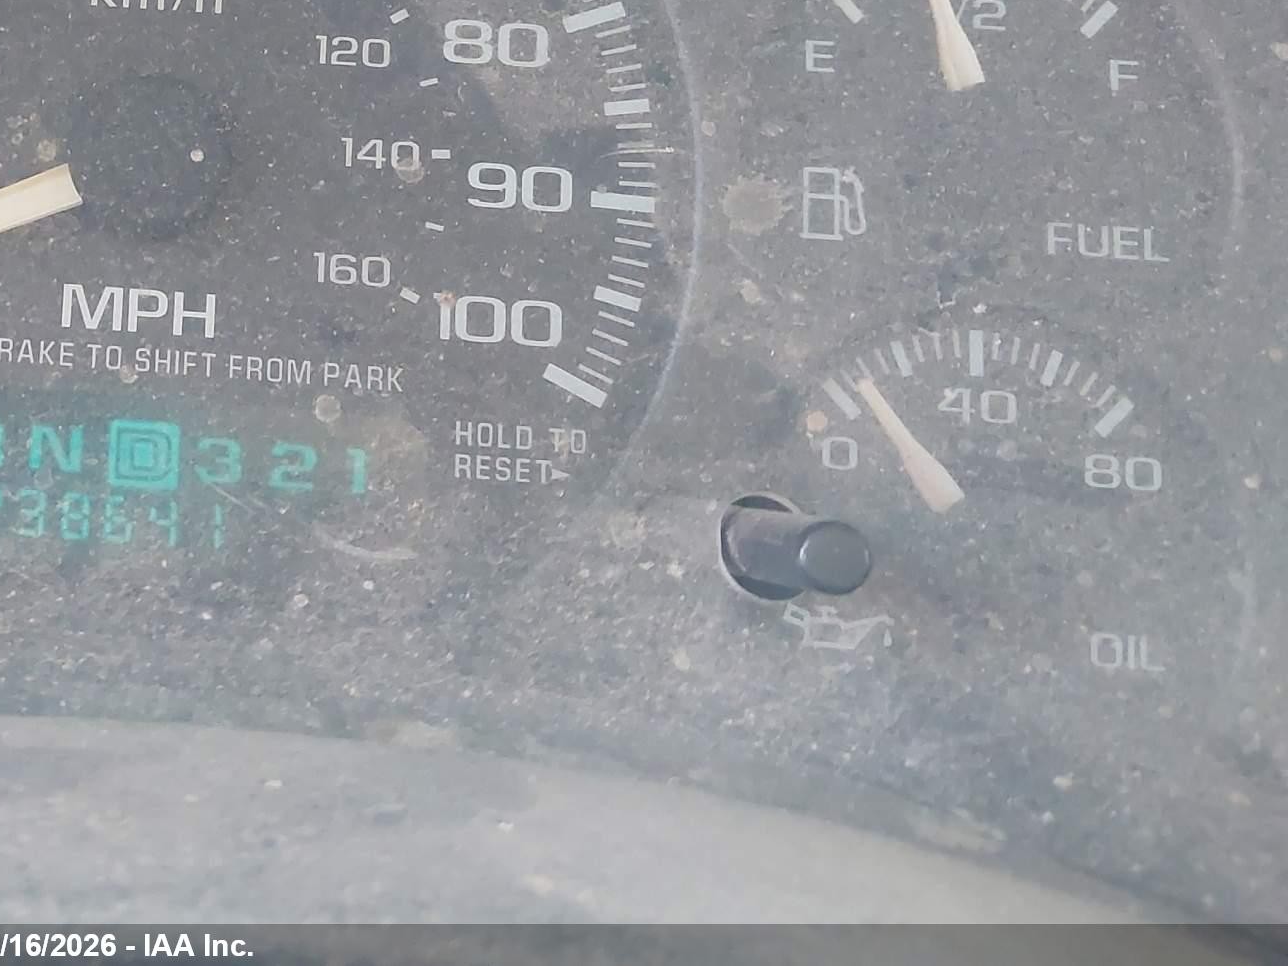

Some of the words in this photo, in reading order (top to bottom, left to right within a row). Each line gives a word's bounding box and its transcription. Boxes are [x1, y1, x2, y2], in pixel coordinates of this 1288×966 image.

[315, 35, 392, 69] 120
[442, 19, 550, 68] 80
[804, 39, 836, 74] E
[1110, 59, 1140, 92] F
[340, 137, 421, 171] 140
[467, 162, 574, 212] 90
[1046, 222, 1171, 263] FUEL
[313, 251, 392, 288] 160
[60, 283, 217, 339] MPH
[432, 291, 564, 348] 100
[85, 343, 122, 371] TO
[134, 346, 217, 378] SHIFT
[227, 354, 312, 385] FROM
[322, 361, 404, 392] PARK
[937, 387, 1019, 426] 40
[455, 420, 533, 450] HOLD
[548, 427, 586, 454] TO
[820, 436, 859, 471] 0
[27, 423, 84, 474] N
[193, 436, 243, 485] 3
[268, 441, 318, 490] 2
[345, 446, 371, 495] 1
[454, 453, 553, 484] RESET
[1083, 454, 1162, 492] 80
[1088, 633, 1166, 672] OIL
